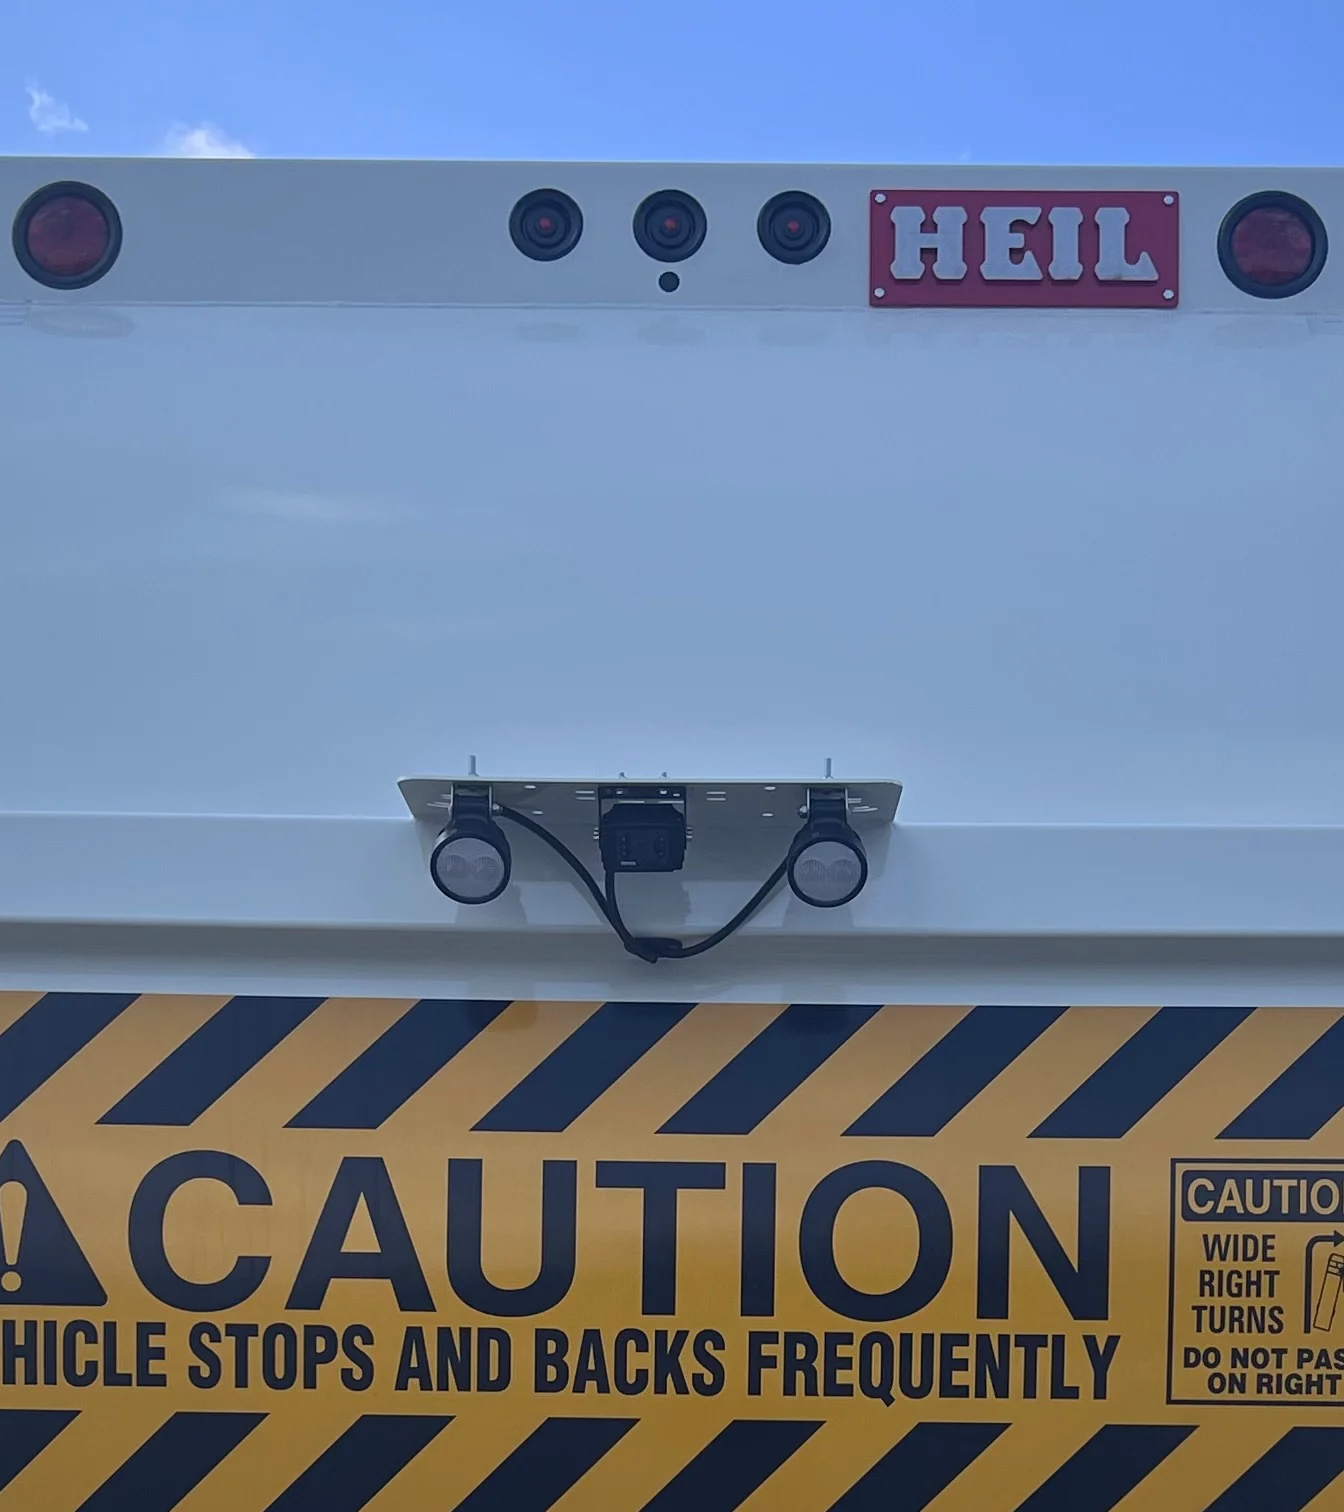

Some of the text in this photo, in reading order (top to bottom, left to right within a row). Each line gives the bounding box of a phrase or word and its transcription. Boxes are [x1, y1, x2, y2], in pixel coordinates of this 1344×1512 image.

[890, 206, 1159, 281] HEIL
[127, 1150, 1112, 1323] CAUTION
[1203, 1234, 1276, 1262] WIDE
[1199, 1270, 1280, 1298] RIGHT
[1192, 1306, 1284, 1334] TURNS
[188, 1321, 375, 1391] STOPS
[394, 1326, 512, 1393] AND
[534, 1328, 726, 1396] BACKS
[748, 1331, 1121, 1407] FREQUENTLY
[1184, 1347, 1221, 1369] DO
[1231, 1348, 1288, 1369] NOT
[1208, 1373, 1342, 1395] ON RIGHT
